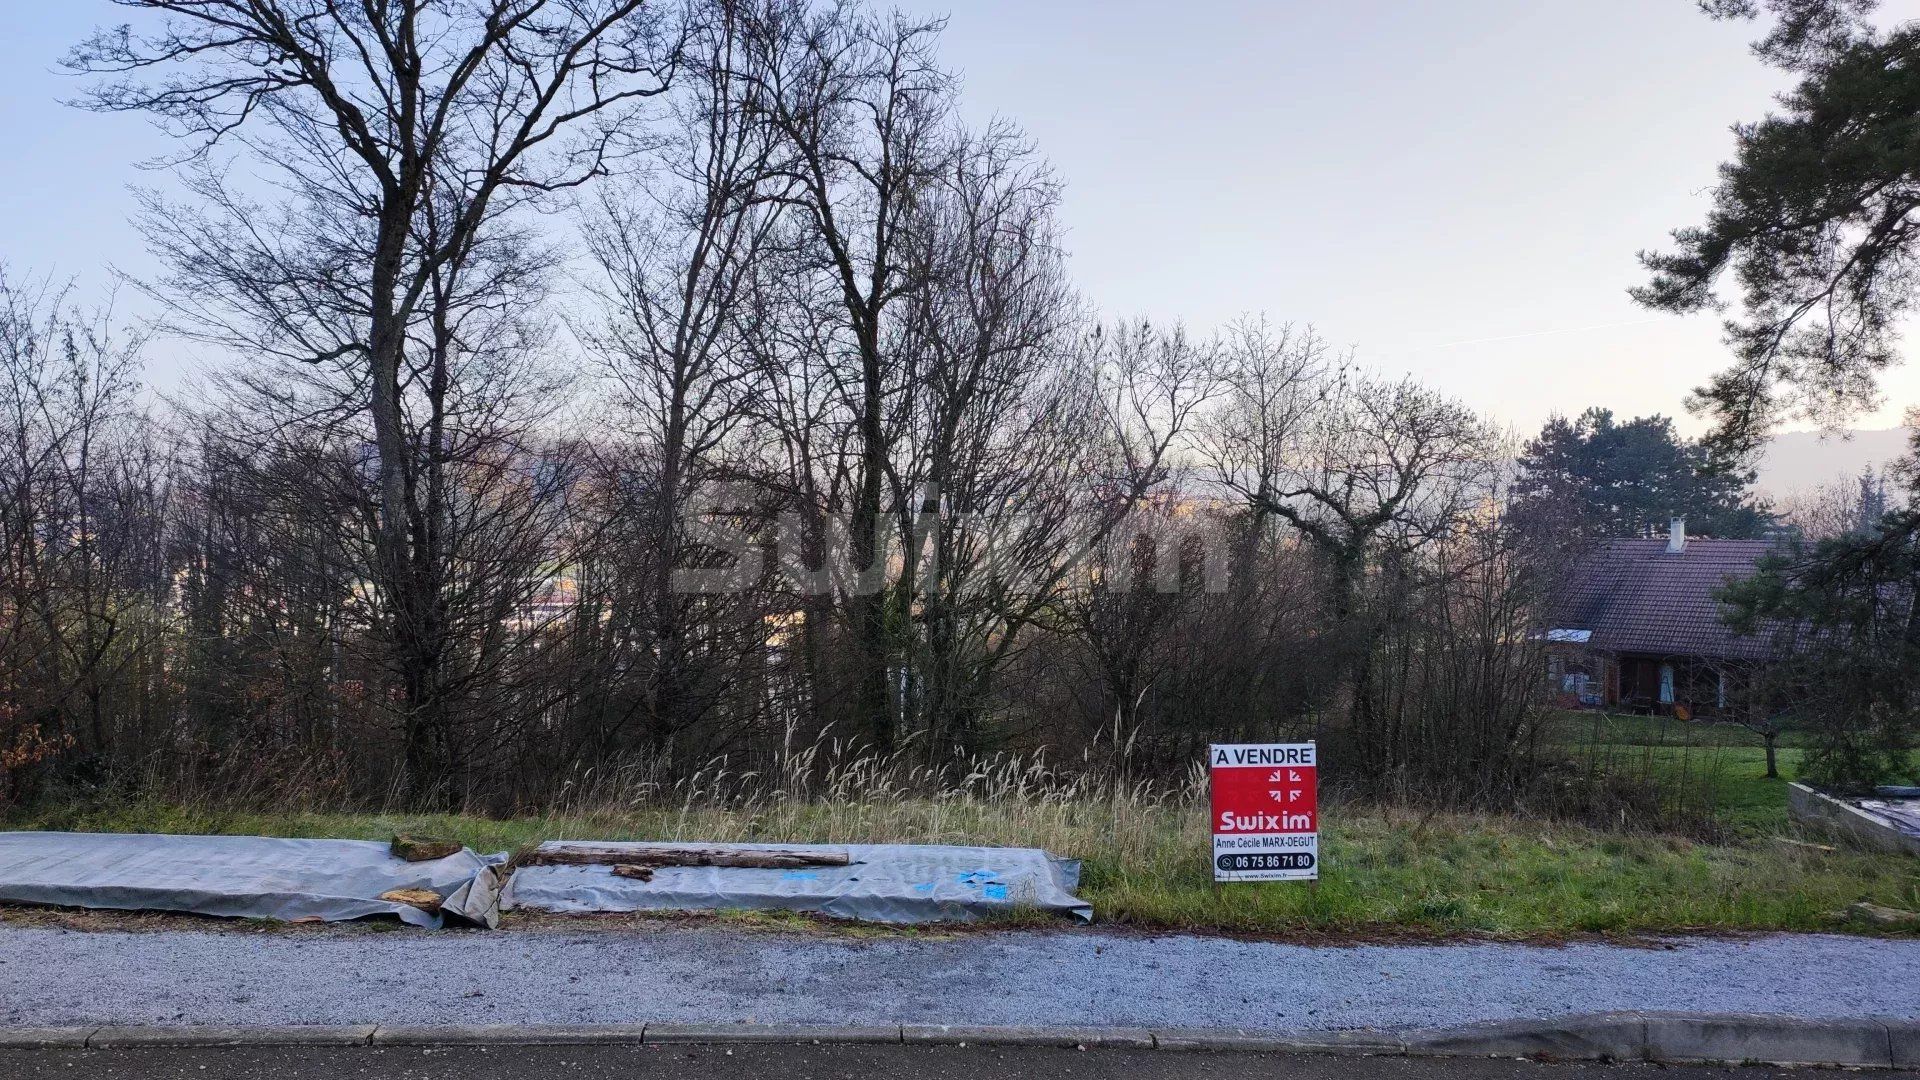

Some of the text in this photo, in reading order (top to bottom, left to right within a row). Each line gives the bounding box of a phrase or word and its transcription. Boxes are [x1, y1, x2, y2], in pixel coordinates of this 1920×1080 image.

[1216, 748, 1311, 765] A VENDRE
[1220, 811, 1311, 831] Swixim
[1216, 836, 1315, 848] Anne Cécile MARX-DEGUT
[1236, 855, 1310, 868] 06 75 86 71 80
